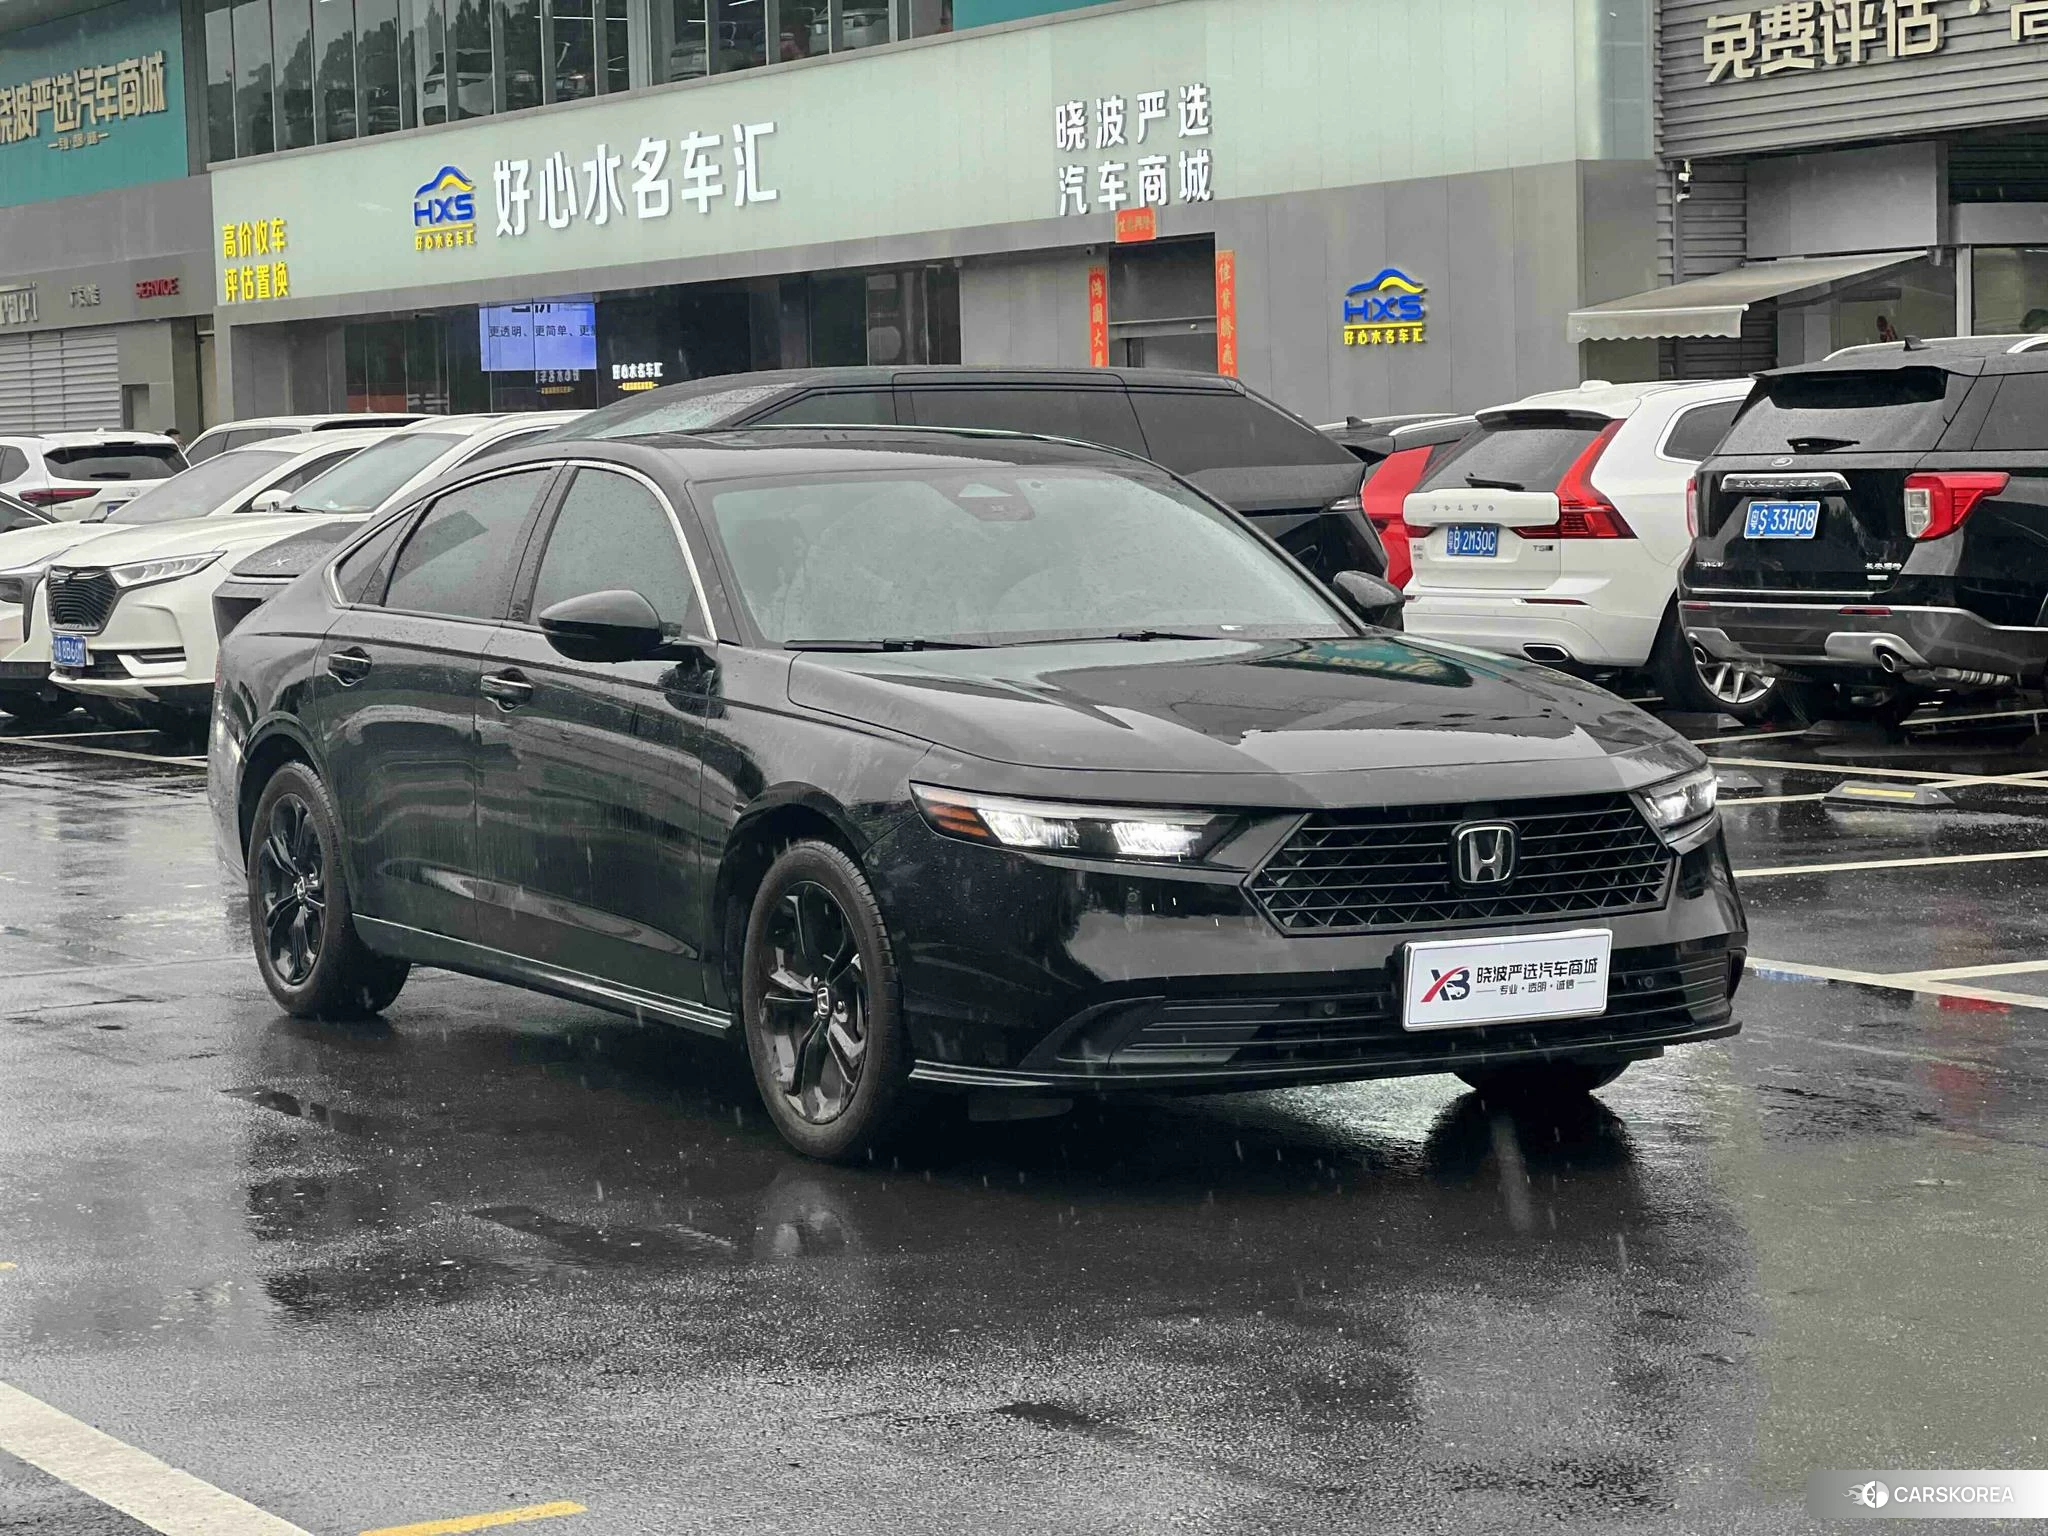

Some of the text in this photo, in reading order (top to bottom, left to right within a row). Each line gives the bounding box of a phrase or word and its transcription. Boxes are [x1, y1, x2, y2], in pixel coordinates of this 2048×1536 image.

[1703, 0, 1939, 83] 免费评估
[1055, 83, 1210, 152] 晓波严选
[493, 121, 778, 237] 好心水名车汇
[1058, 149, 1212, 216] 汽车商城
[414, 193, 475, 226] HXS
[222, 217, 286, 258] 高价收车
[415, 229, 475, 251] 好心水名车汇
[136, 277, 180, 299] SERVICE
[224, 260, 288, 302] 评估置换
[1344, 294, 1423, 322] HXS
[1344, 327, 1423, 345] 好心水名车汇
[1476, 957, 1598, 983] 晓波严选汽车商城
